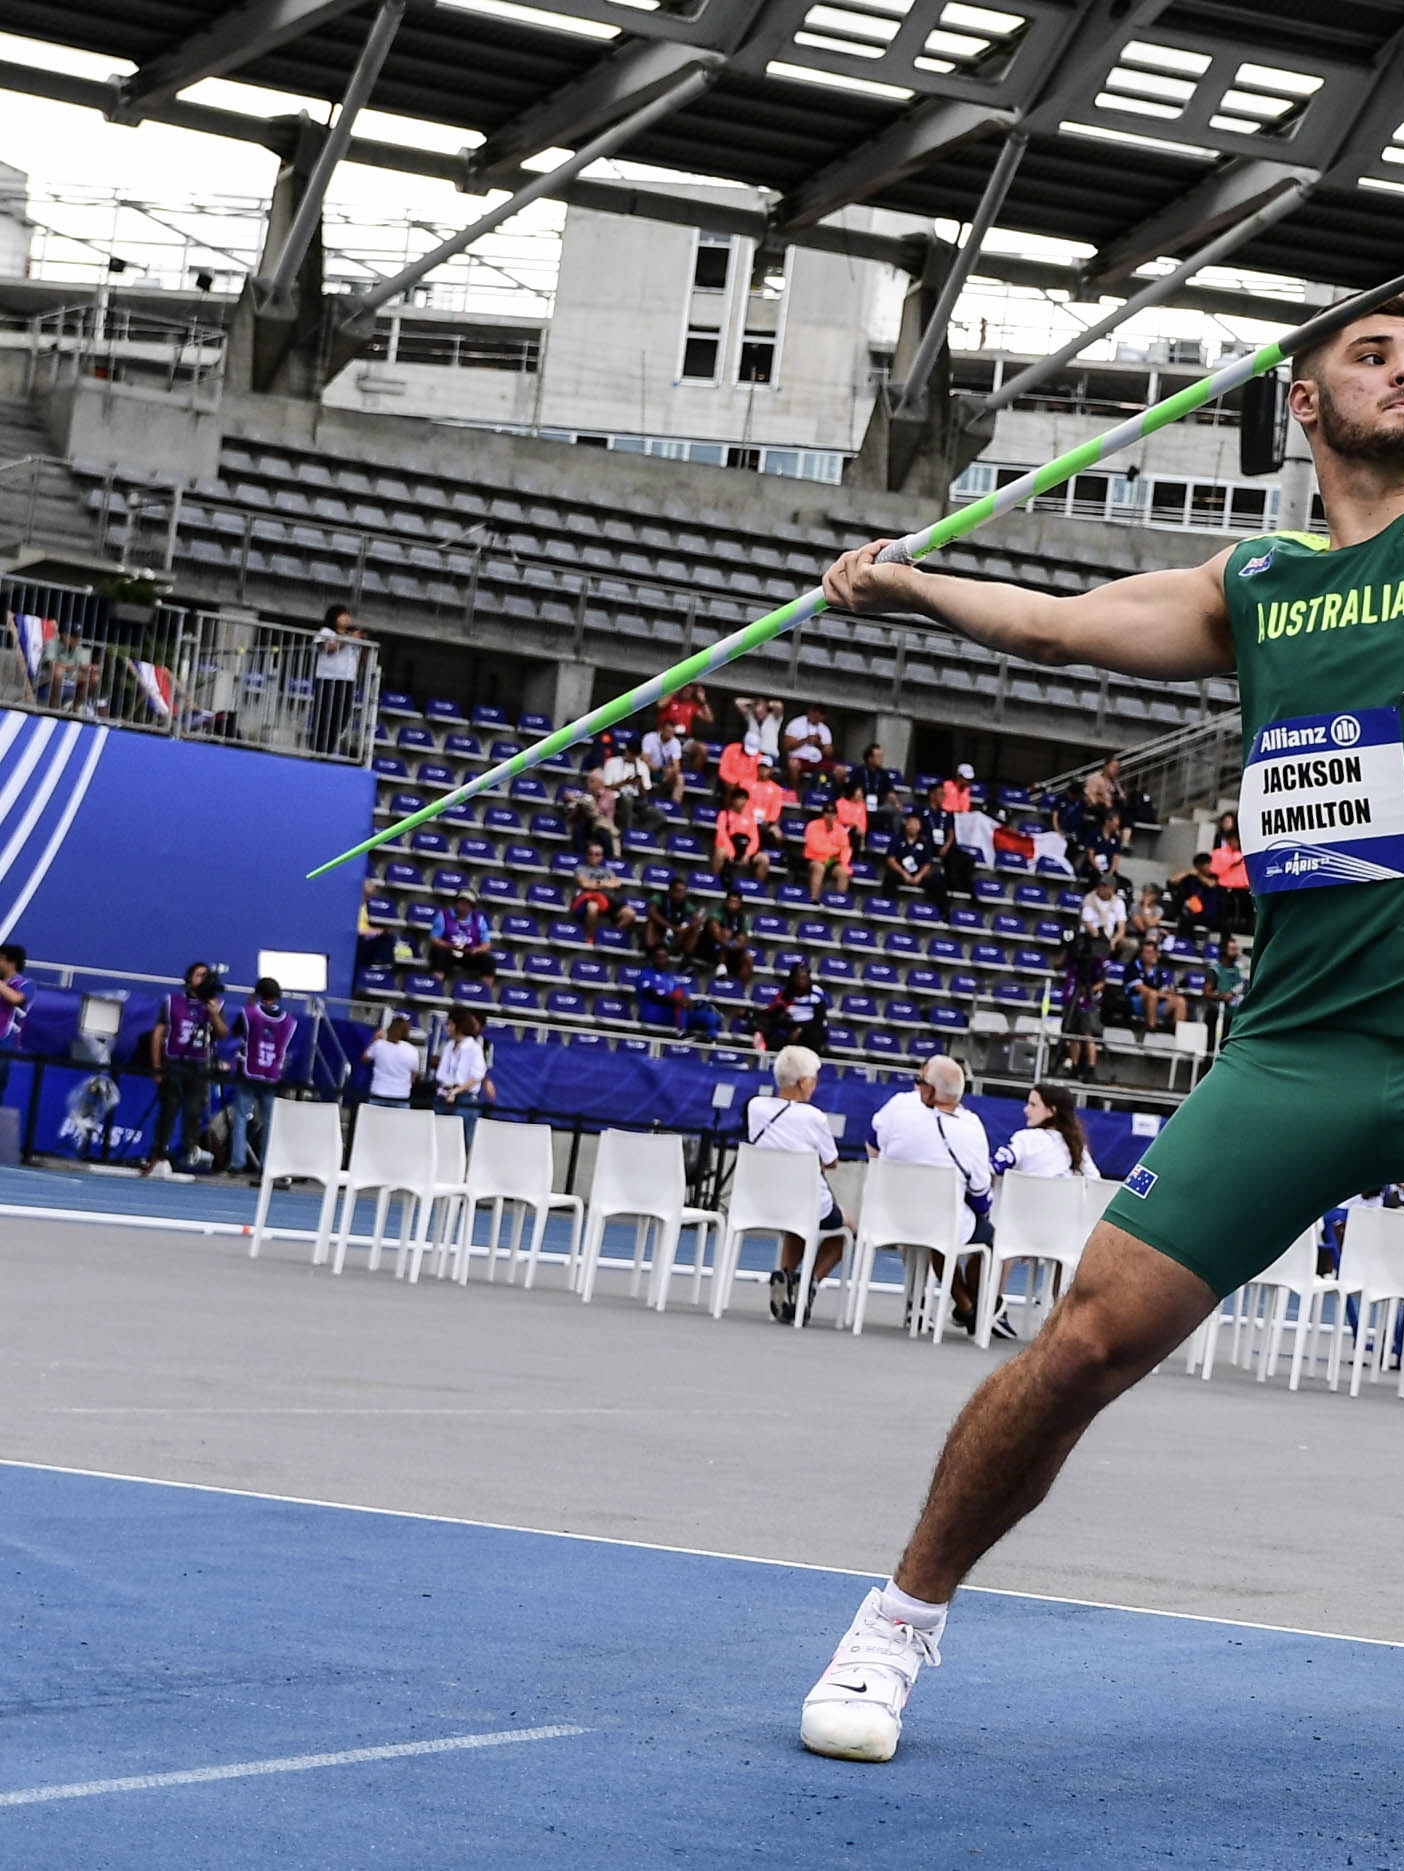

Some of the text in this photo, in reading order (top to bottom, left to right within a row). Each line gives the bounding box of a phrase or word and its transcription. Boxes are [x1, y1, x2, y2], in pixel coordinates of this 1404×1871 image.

[1260, 726, 1328, 753] Allianz
[1263, 756, 1362, 795] JACKSON
[1261, 798, 1372, 836] HAMILTON
